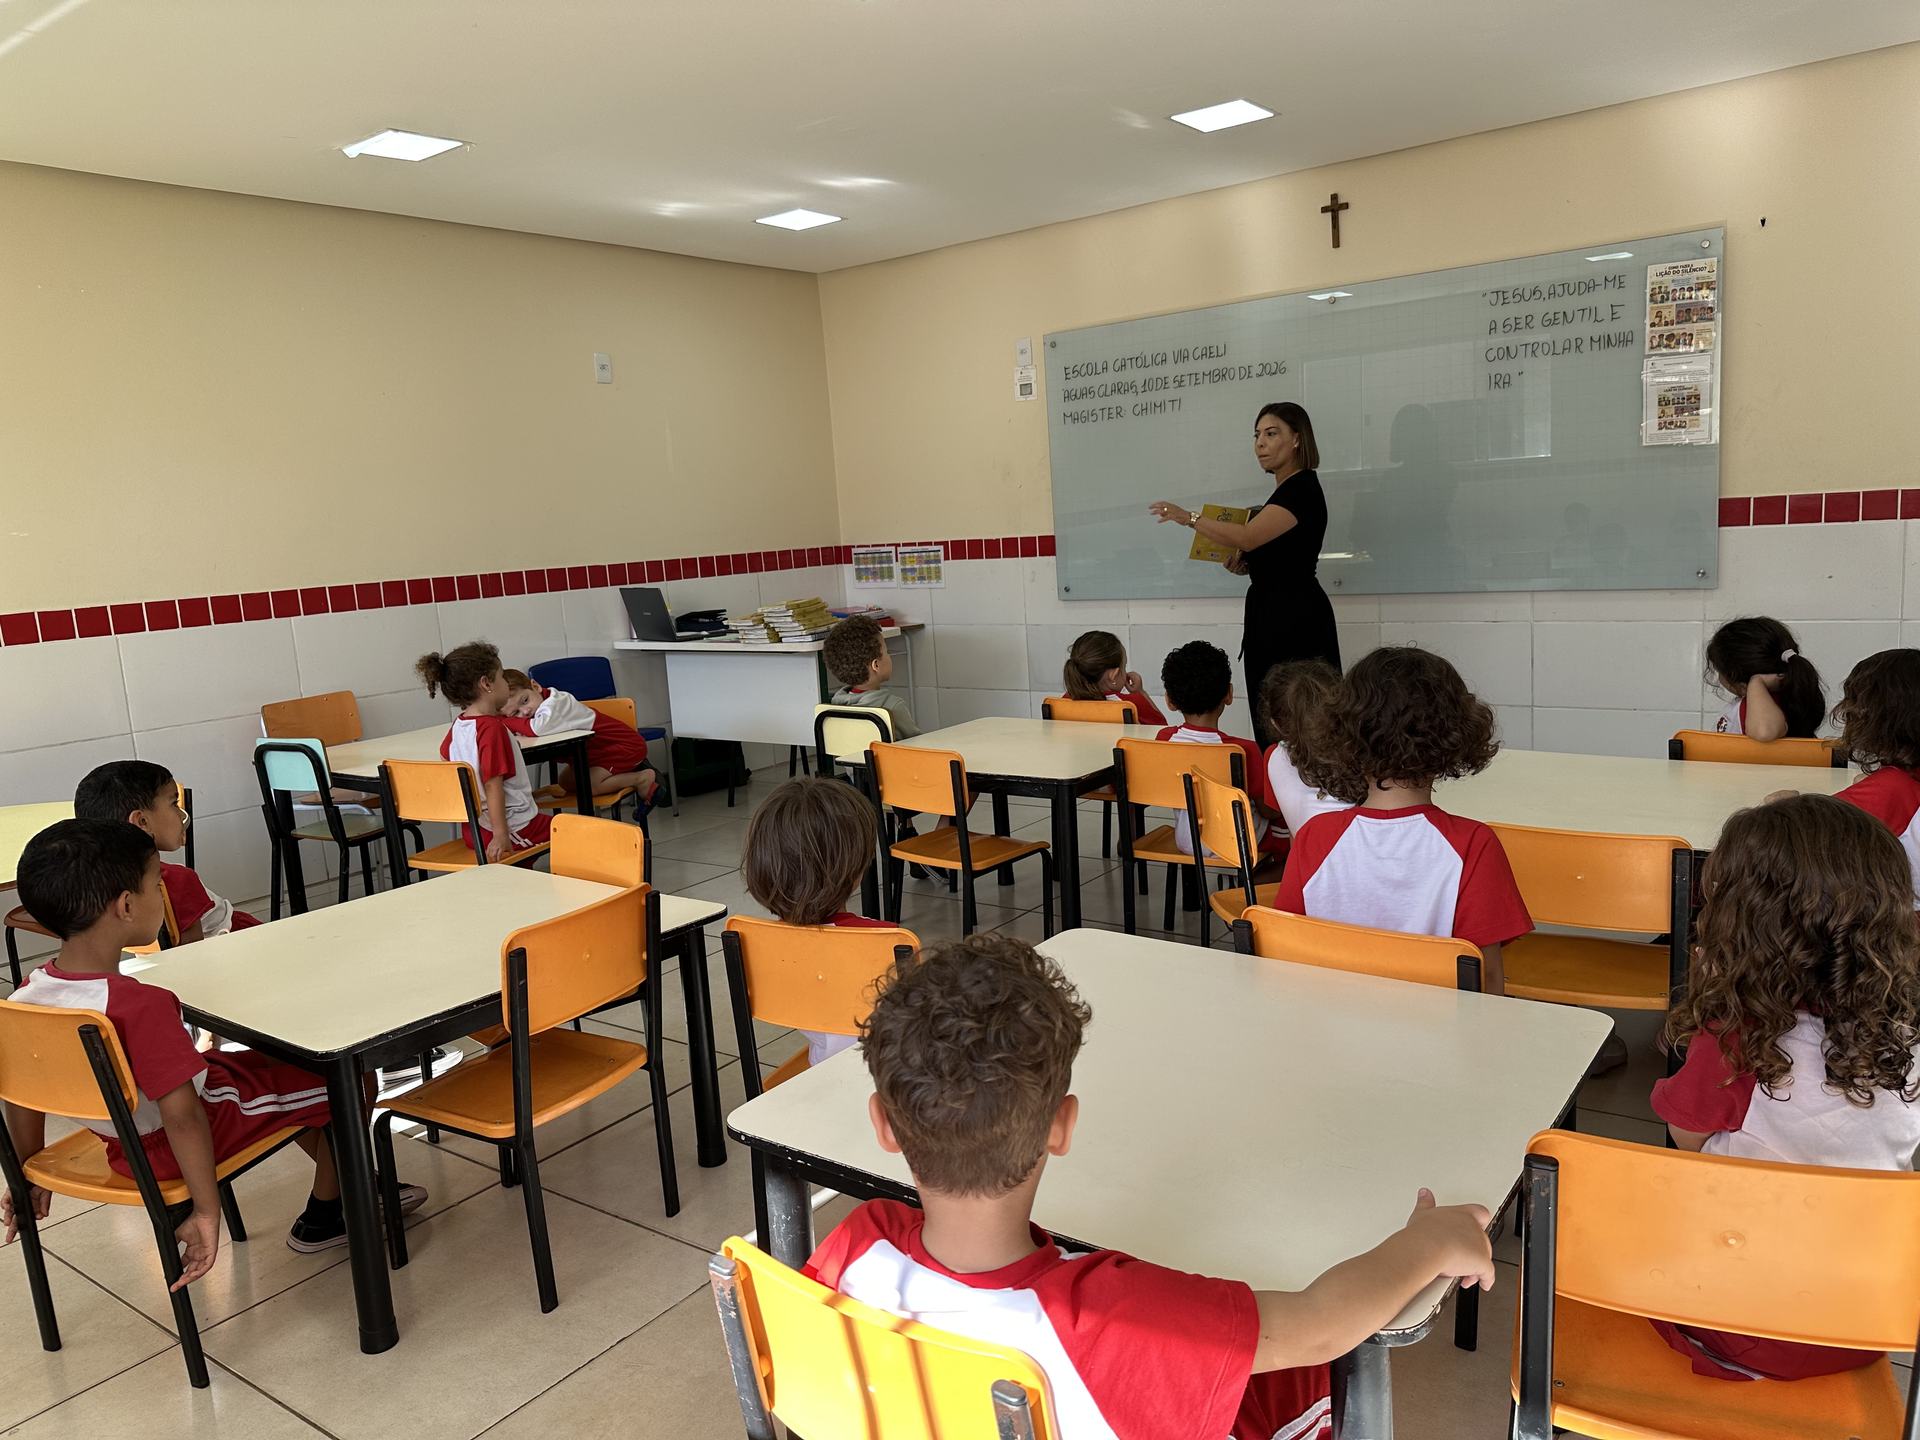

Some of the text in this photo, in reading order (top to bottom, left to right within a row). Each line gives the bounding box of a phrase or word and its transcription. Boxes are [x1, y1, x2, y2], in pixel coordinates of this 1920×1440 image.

[1488, 303, 1625, 335] A SER GENTIL E
[1064, 361, 1108, 380] ESCOLA
[1112, 351, 1167, 373] CATÓLICA
[1172, 347, 1189, 363] VIA
[1192, 343, 1227, 361] CAELI
[1485, 330, 1634, 363] CONTROLAR MINHA
[1140, 377, 1154, 394] 10
[1155, 376, 1169, 391] DE
[1172, 367, 1235, 389] SETEMBRO
[1239, 364, 1253, 380] DE
[1255, 360, 1287, 378] 2026
